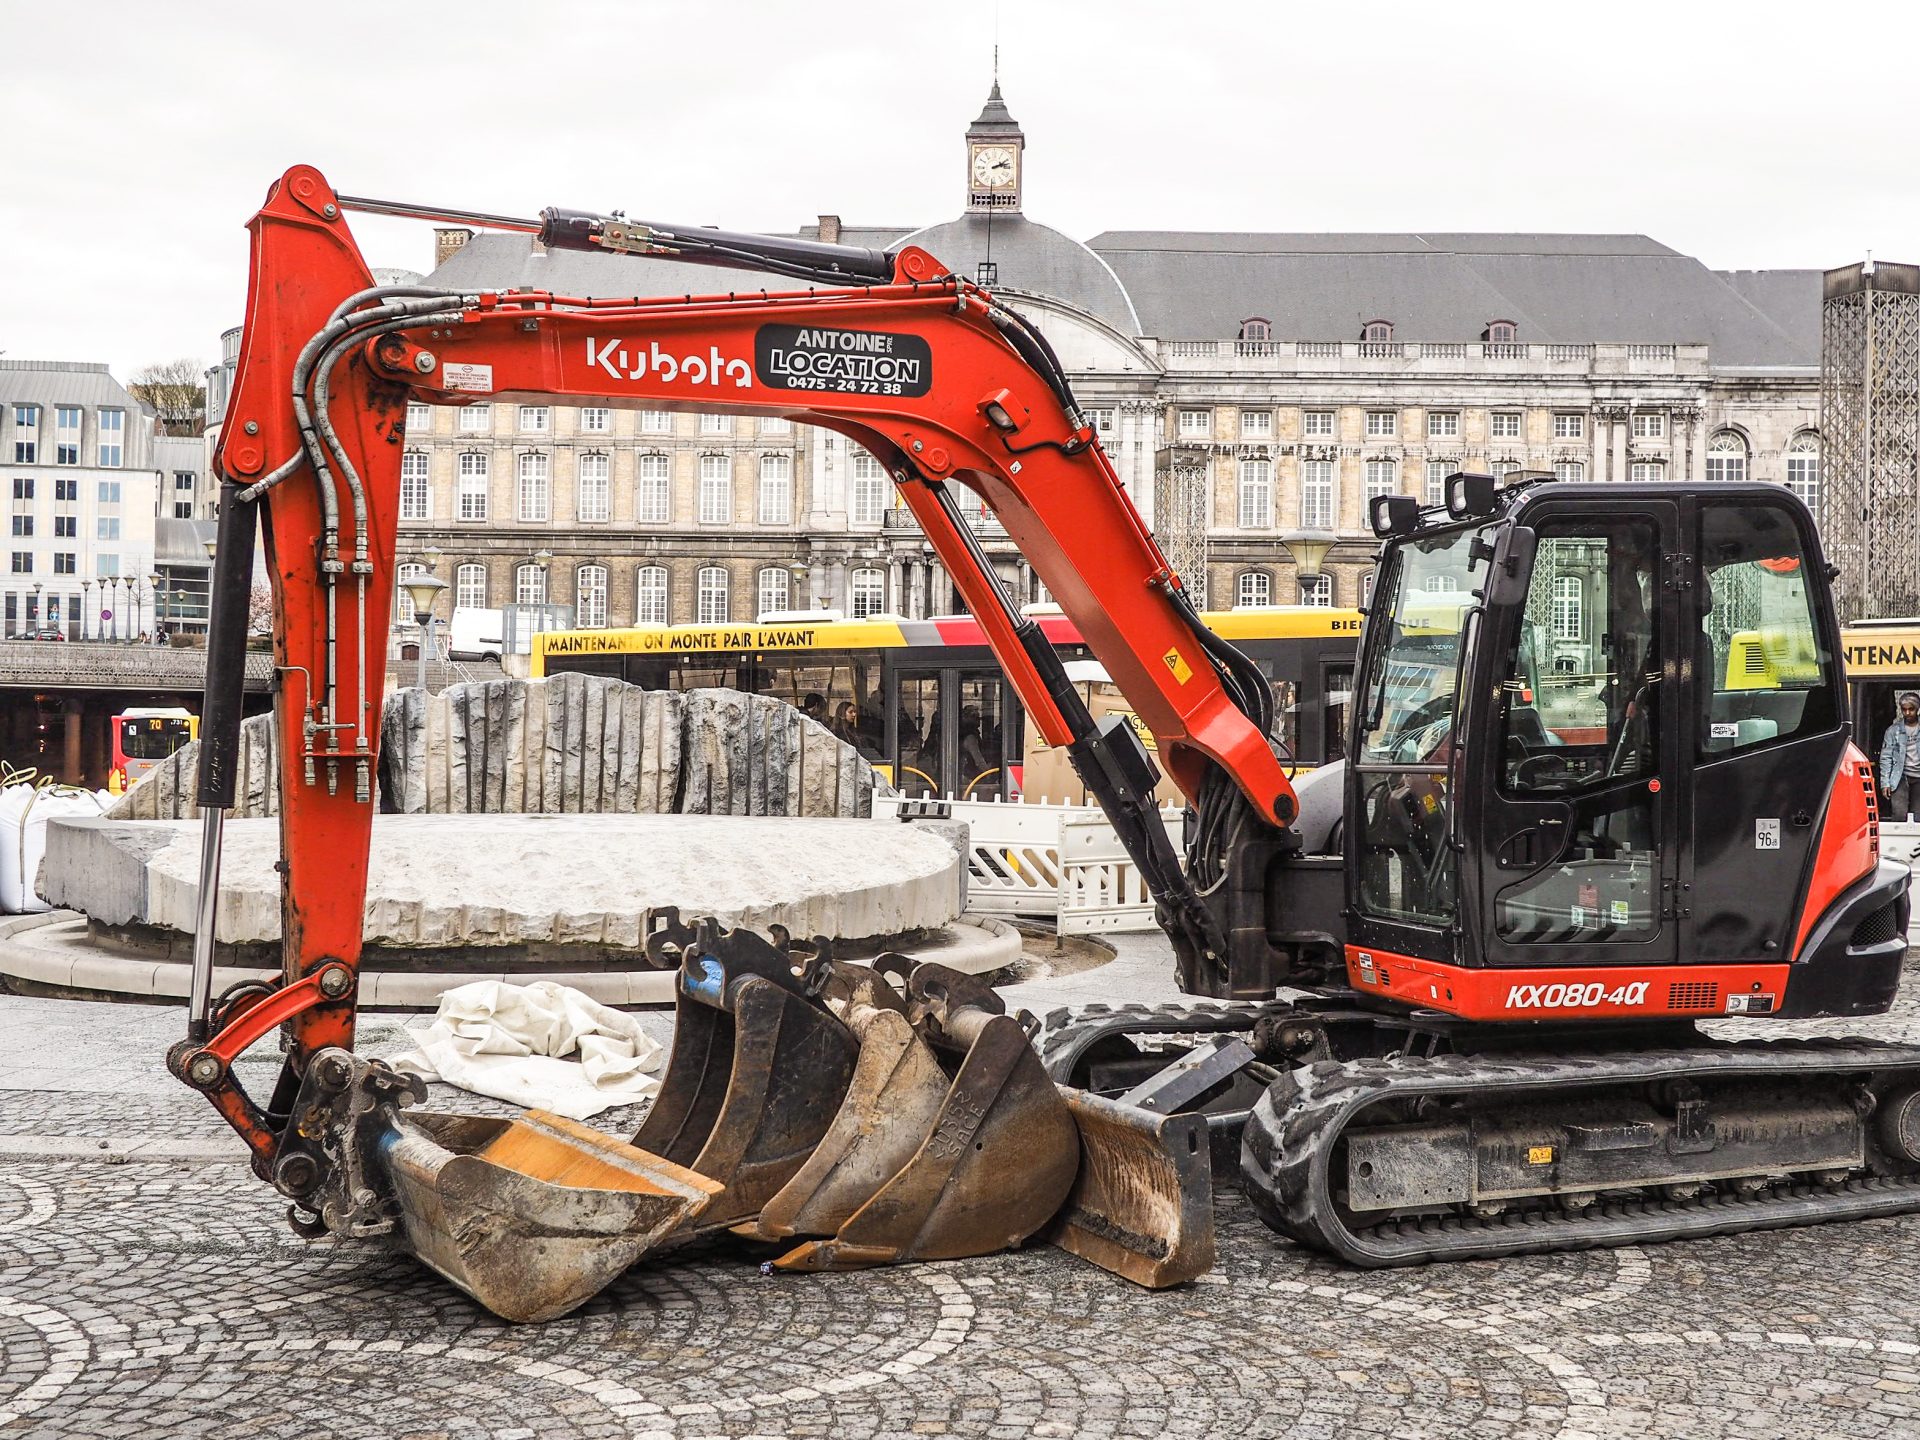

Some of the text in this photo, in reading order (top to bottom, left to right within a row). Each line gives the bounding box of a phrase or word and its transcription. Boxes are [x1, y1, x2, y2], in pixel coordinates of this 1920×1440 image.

[795, 329, 886, 353] ANTOINE
[586, 336, 752, 388] Kubota
[770, 348, 920, 384] LOCATION
[787, 376, 827, 390] 0475
[837, 380, 857, 393] 24
[860, 381, 879, 394] 72
[883, 383, 902, 395] 38
[644, 634, 663, 649] ON
[670, 632, 717, 649] MONTE
[723, 631, 752, 648] PAR
[758, 630, 815, 647] L'AVANT
[149, 720, 163, 729] 70
[1758, 832, 1772, 847] 96
[947, 1102, 986, 1158] SACE
